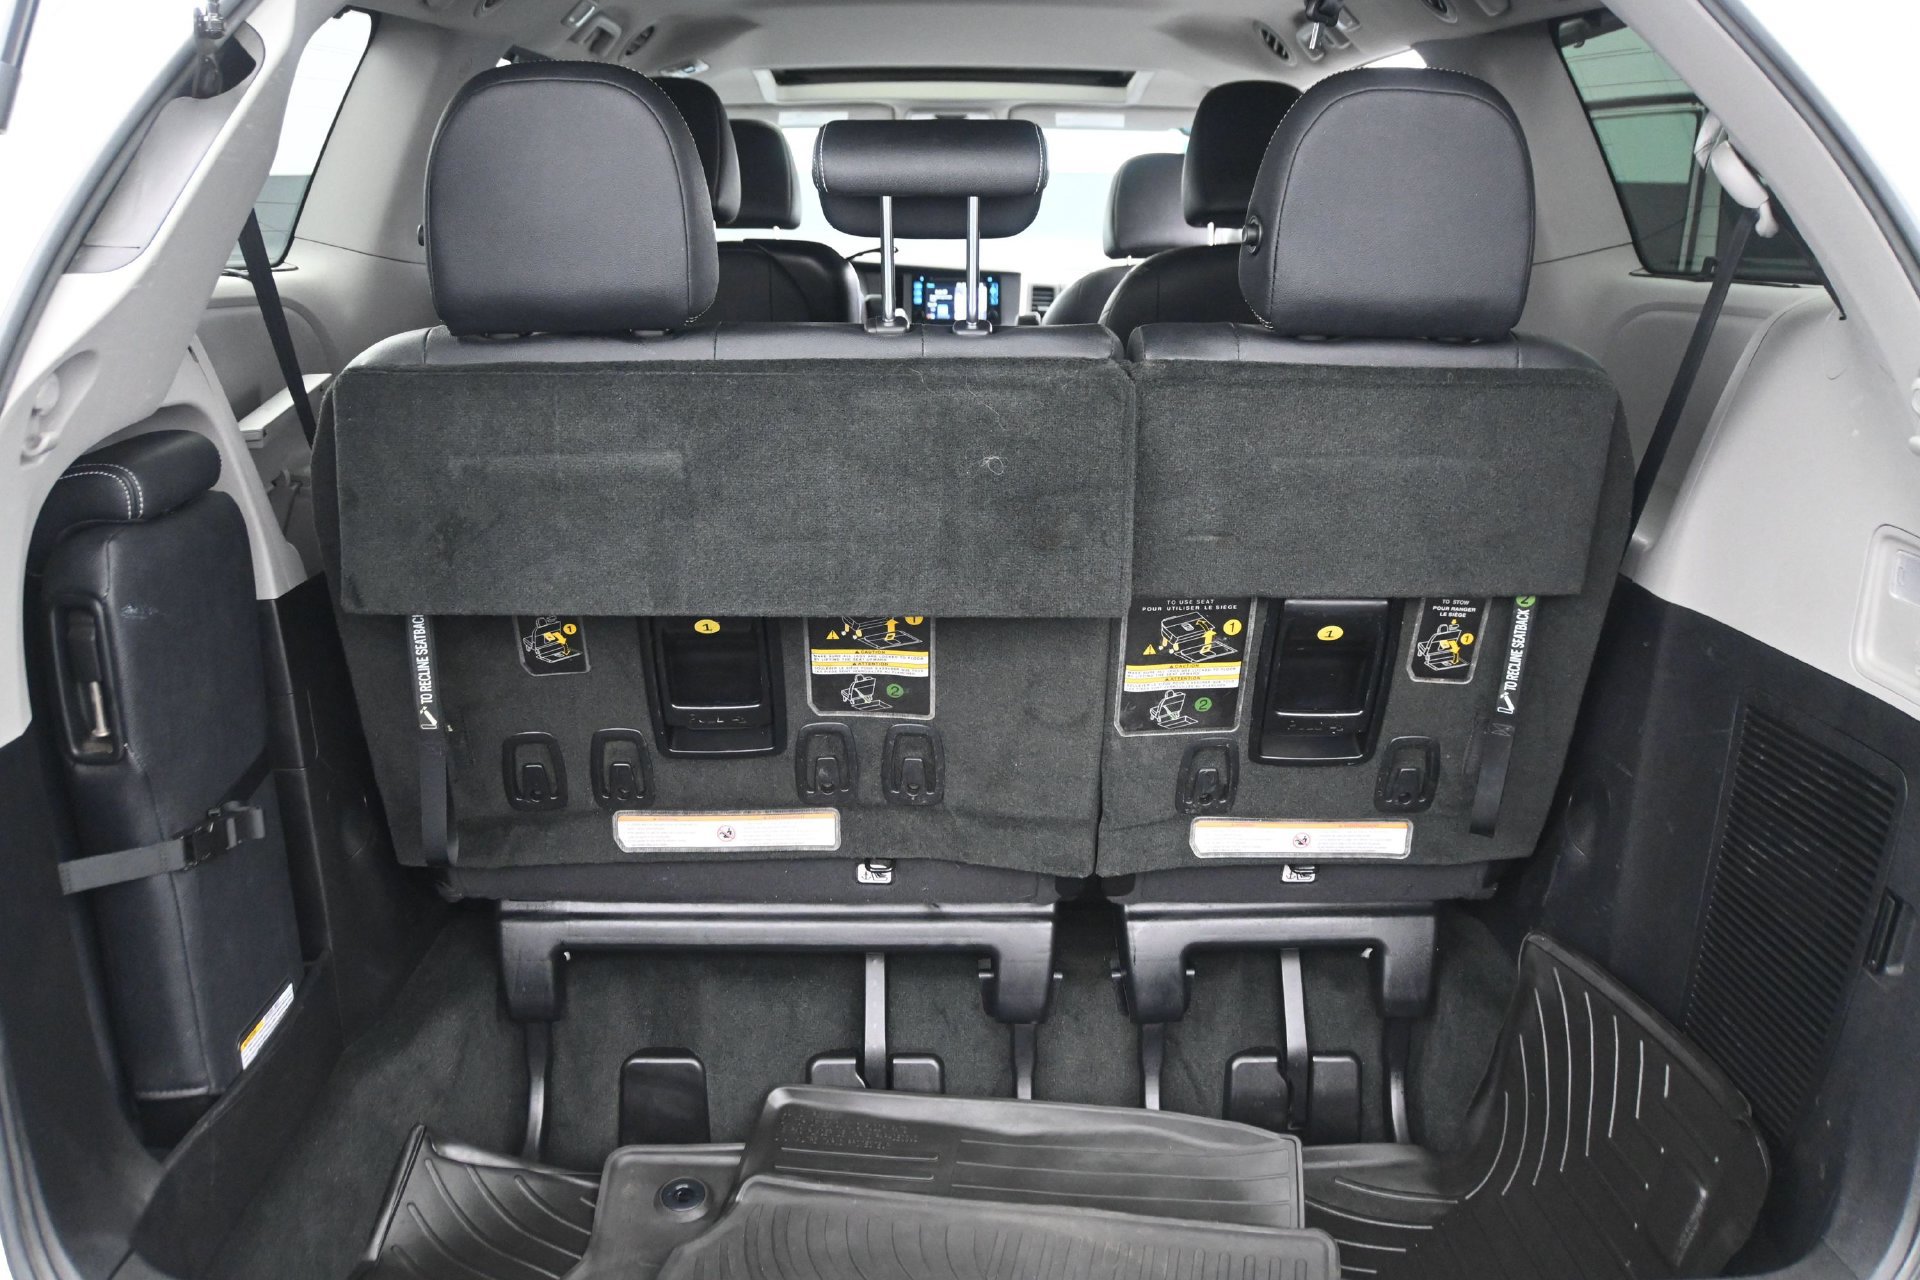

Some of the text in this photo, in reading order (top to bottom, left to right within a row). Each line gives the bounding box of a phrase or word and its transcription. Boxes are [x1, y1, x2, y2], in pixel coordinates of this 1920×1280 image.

[412, 614, 433, 704] TO RECLINE SEATBAC
[1504, 608, 1530, 691] TO RECLINE SEATBACK
